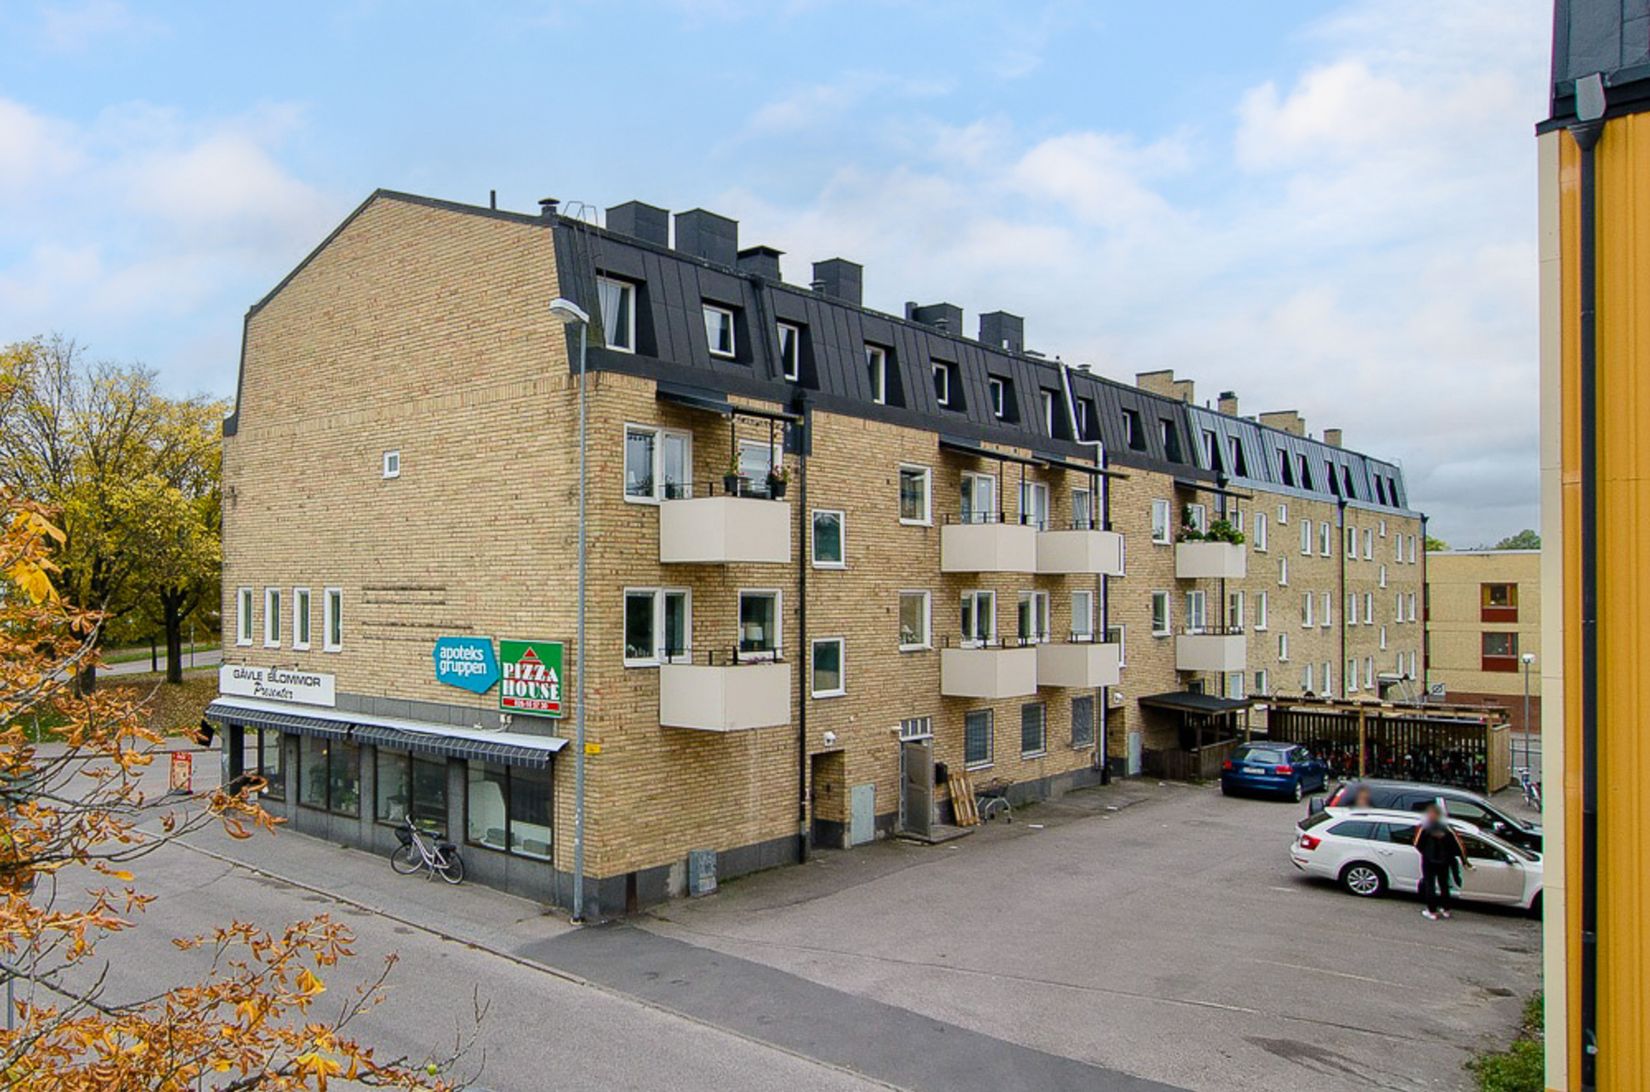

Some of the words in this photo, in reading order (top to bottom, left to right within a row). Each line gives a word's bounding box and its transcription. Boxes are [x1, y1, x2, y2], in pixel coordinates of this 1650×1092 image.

[440, 645, 484, 661] apoteks
[440, 660, 487, 677] gruppen
[502, 662, 559, 682] PIZZA
[502, 679, 560, 700] HOUSE
